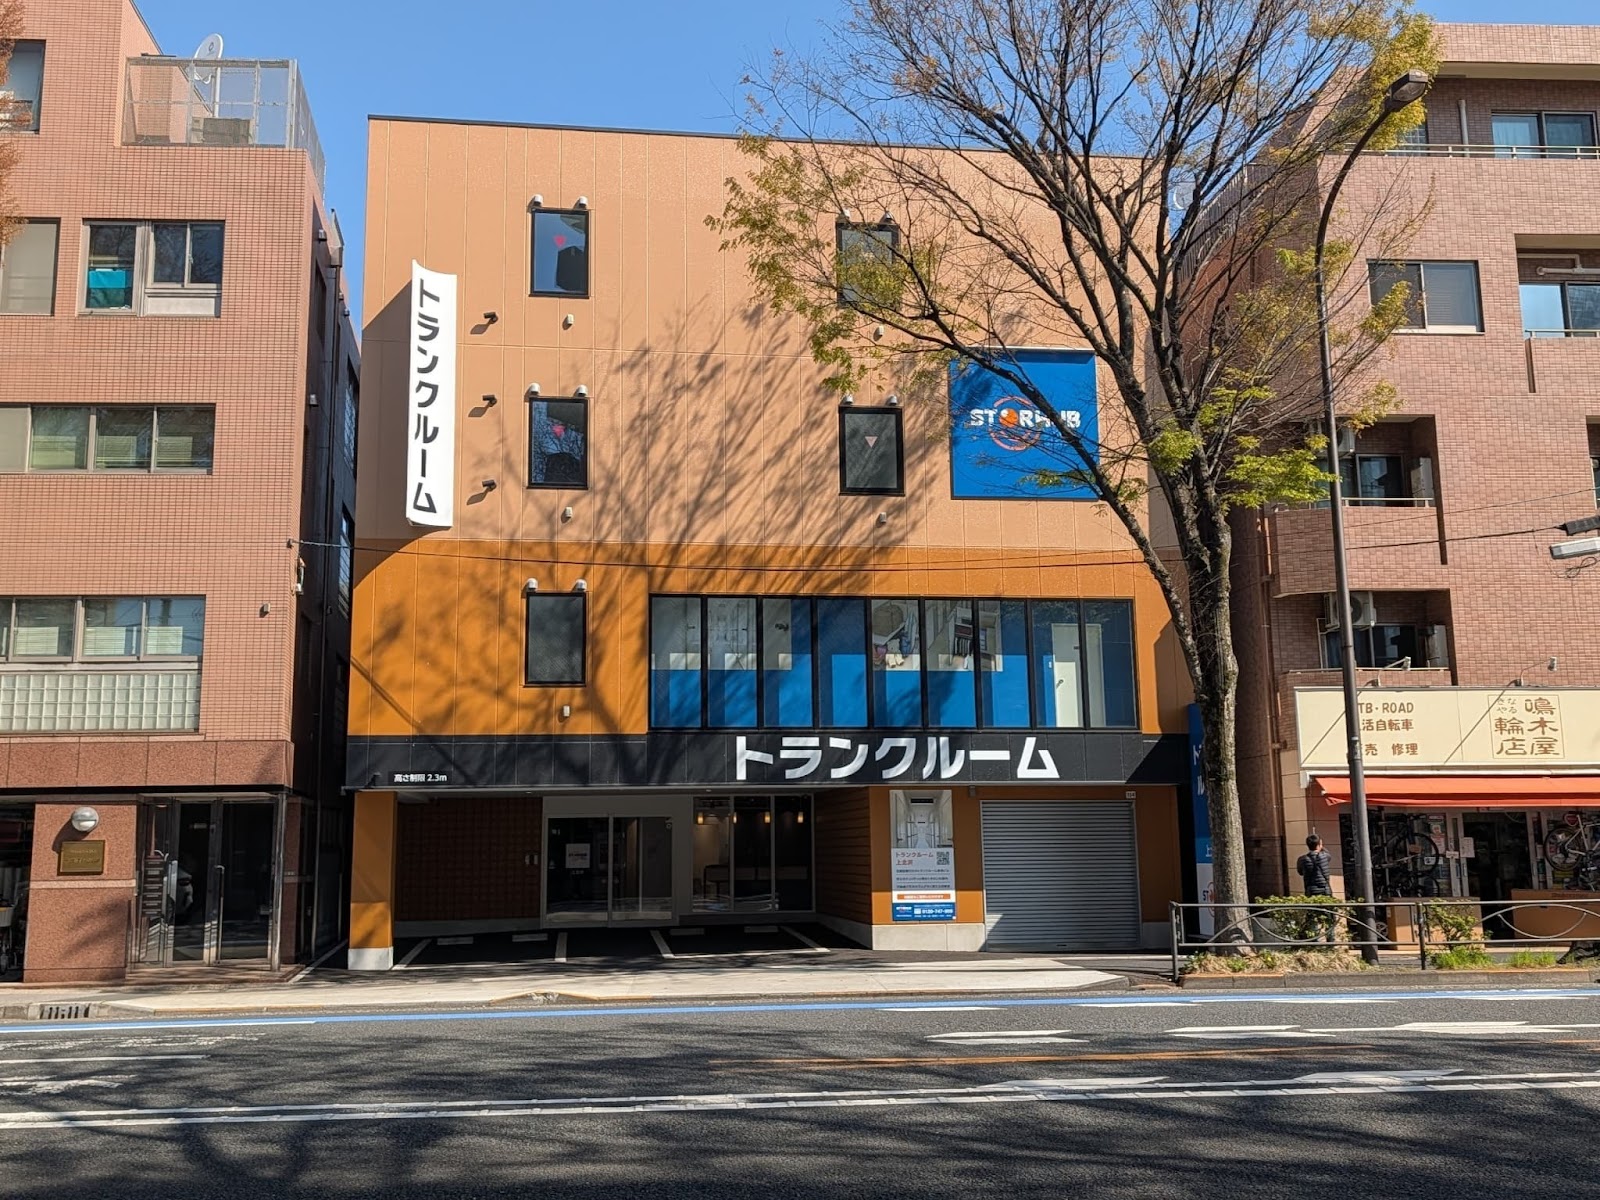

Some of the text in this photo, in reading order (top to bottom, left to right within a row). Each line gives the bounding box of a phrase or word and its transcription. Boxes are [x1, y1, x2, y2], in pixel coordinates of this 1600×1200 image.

[412, 278, 440, 514] トランクルーム
[1358, 702, 1414, 714] TB・ROAD
[1360, 718, 1414, 732] 活自転車
[1524, 697, 1560, 756] 鳴木屋
[1361, 743, 1419, 756] 売 修理
[736, 735, 1061, 781] トランクルーム
[393, 773, 448, 783] 高さ制限 2.3m
